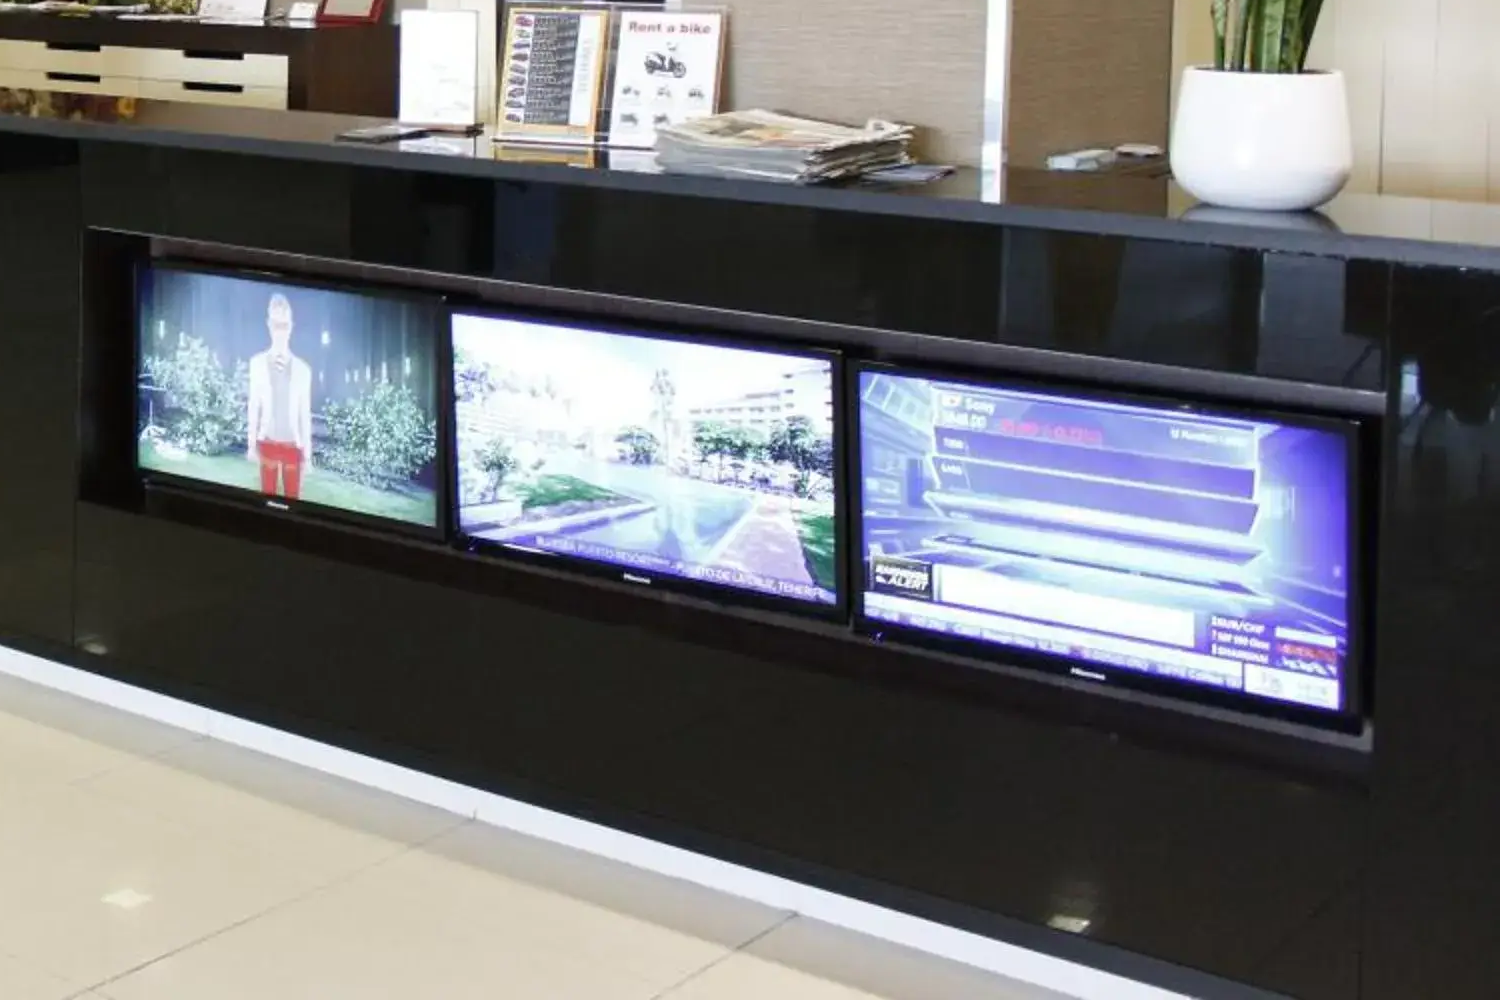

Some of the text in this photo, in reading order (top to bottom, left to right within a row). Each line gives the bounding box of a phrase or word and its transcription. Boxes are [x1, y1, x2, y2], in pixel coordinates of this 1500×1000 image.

[629, 21, 712, 35] Rent a bike
